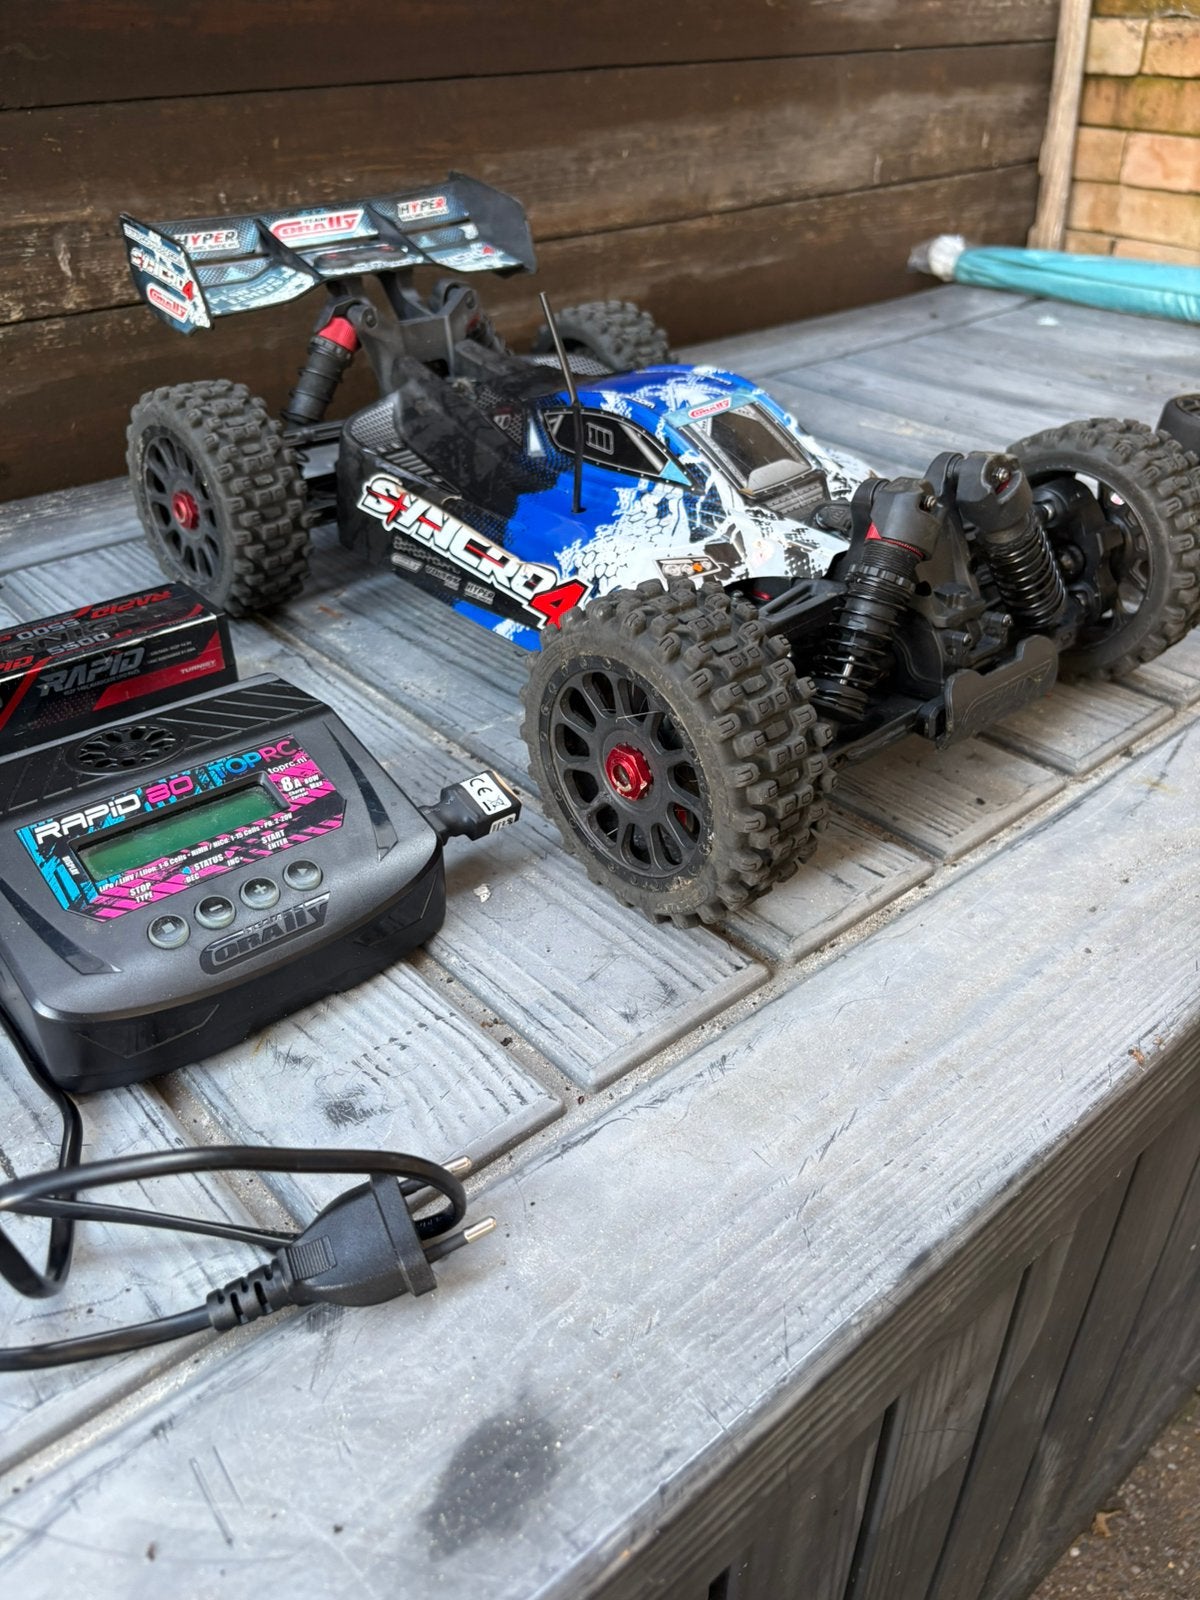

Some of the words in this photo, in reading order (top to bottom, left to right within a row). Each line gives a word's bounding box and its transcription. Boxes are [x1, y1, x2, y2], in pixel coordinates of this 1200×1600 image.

[400, 197, 446, 214] HYPER
[174, 231, 236, 247] HYPER
[48, 632, 110, 656] 5500
[35, 647, 145, 697] RAPID
[267, 755, 309, 775] toprc.nl
[261, 829, 285, 844] START
[267, 837, 289, 850] ENTER
[169, 854, 187, 866] Cells
[244, 825, 260, 836] Cells
[194, 853, 224, 871] STATUS
[129, 882, 152, 897] STOP
[135, 891, 154, 904] TYPE
